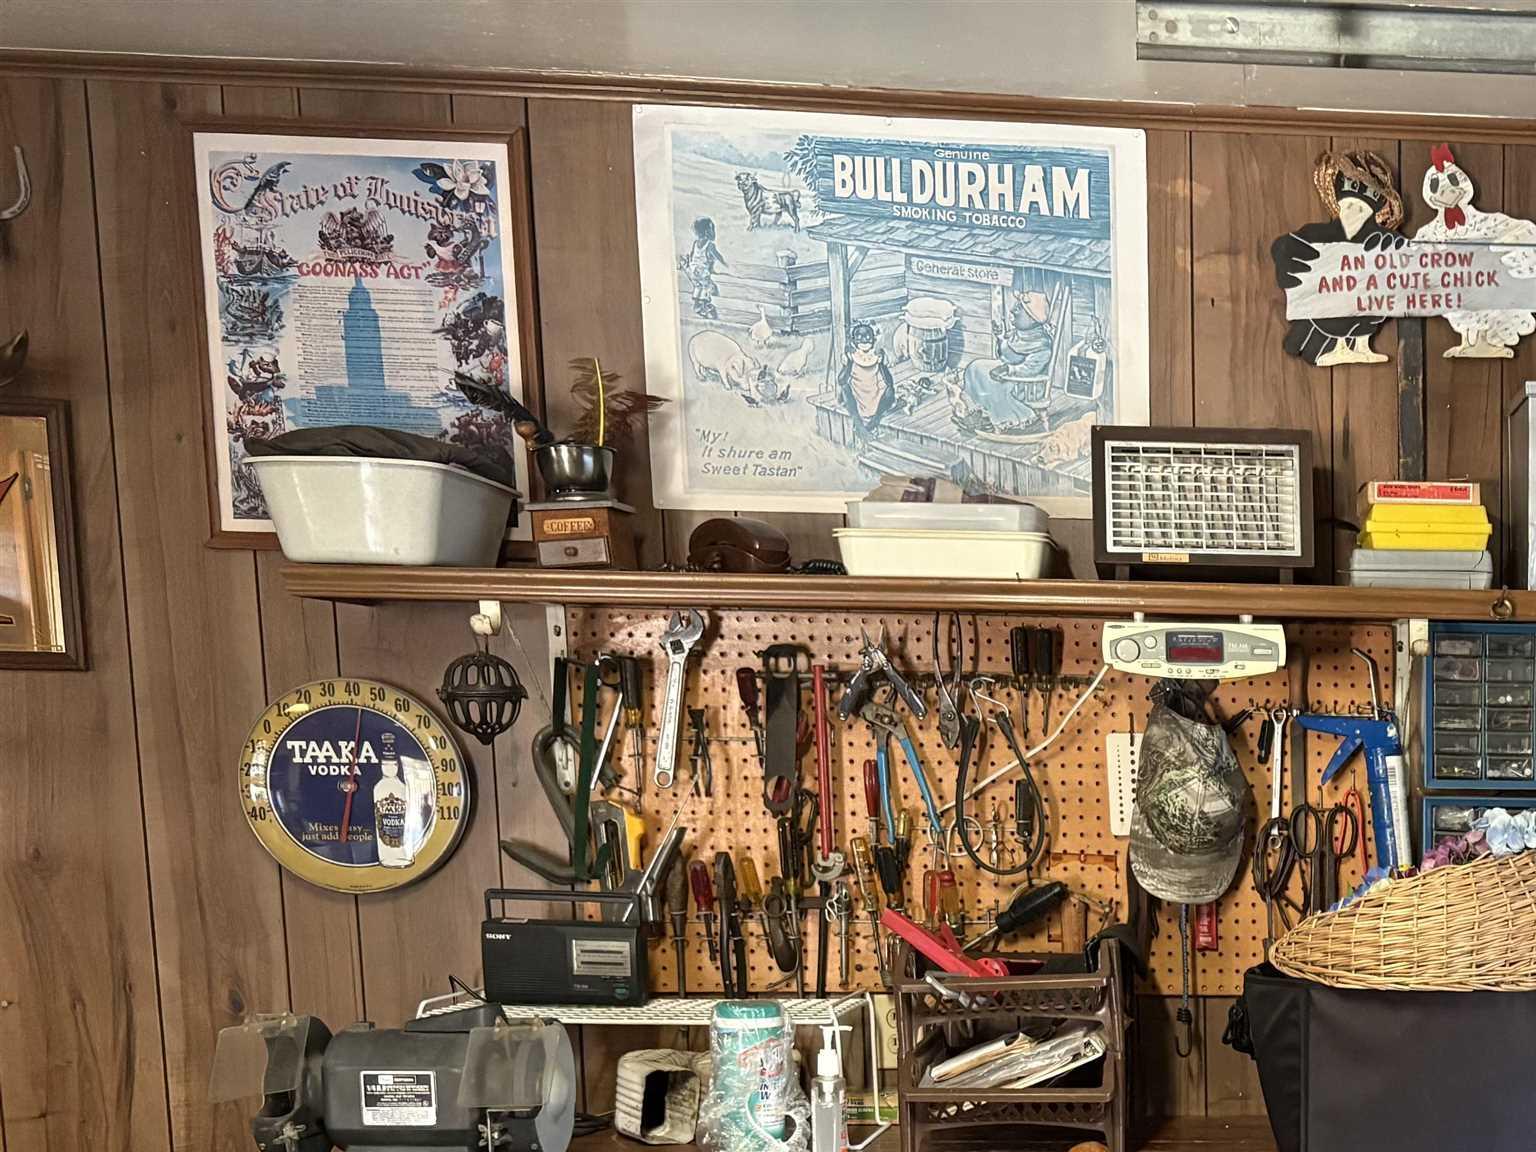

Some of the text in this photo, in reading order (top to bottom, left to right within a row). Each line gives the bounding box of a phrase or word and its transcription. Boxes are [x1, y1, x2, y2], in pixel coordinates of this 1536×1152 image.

[934, 148, 990, 161] Genuine
[833, 154, 1091, 220] BULL DURHAM
[893, 205, 1026, 229] SMOKING TOBACCO
[1340, 251, 1474, 271] AN OLD CROW
[916, 259, 1000, 280] General Store
[1318, 270, 1500, 294] AND A CUTE CHICK
[1356, 292, 1462, 312] LIVE HERE!
[702, 446, 792, 461] It shure am
[702, 462, 748, 476] Sweet
[296, 688, 312, 706] 20
[319, 681, 335, 698] 30
[344, 681, 360, 697] 40
[369, 686, 386, 702] 50
[394, 697, 410, 713] 60
[263, 718, 272, 735] 0
[415, 714, 431, 730] 70
[286, 740, 379, 764] TAAKA
[308, 765, 362, 776] VODKA
[441, 758, 456, 773] 90
[440, 805, 459, 821] 110
[308, 822, 339, 833] Mixes
[382, 817, 406, 827] VODKA
[302, 831, 373, 842] just add eople
[485, 932, 512, 940] SONY
